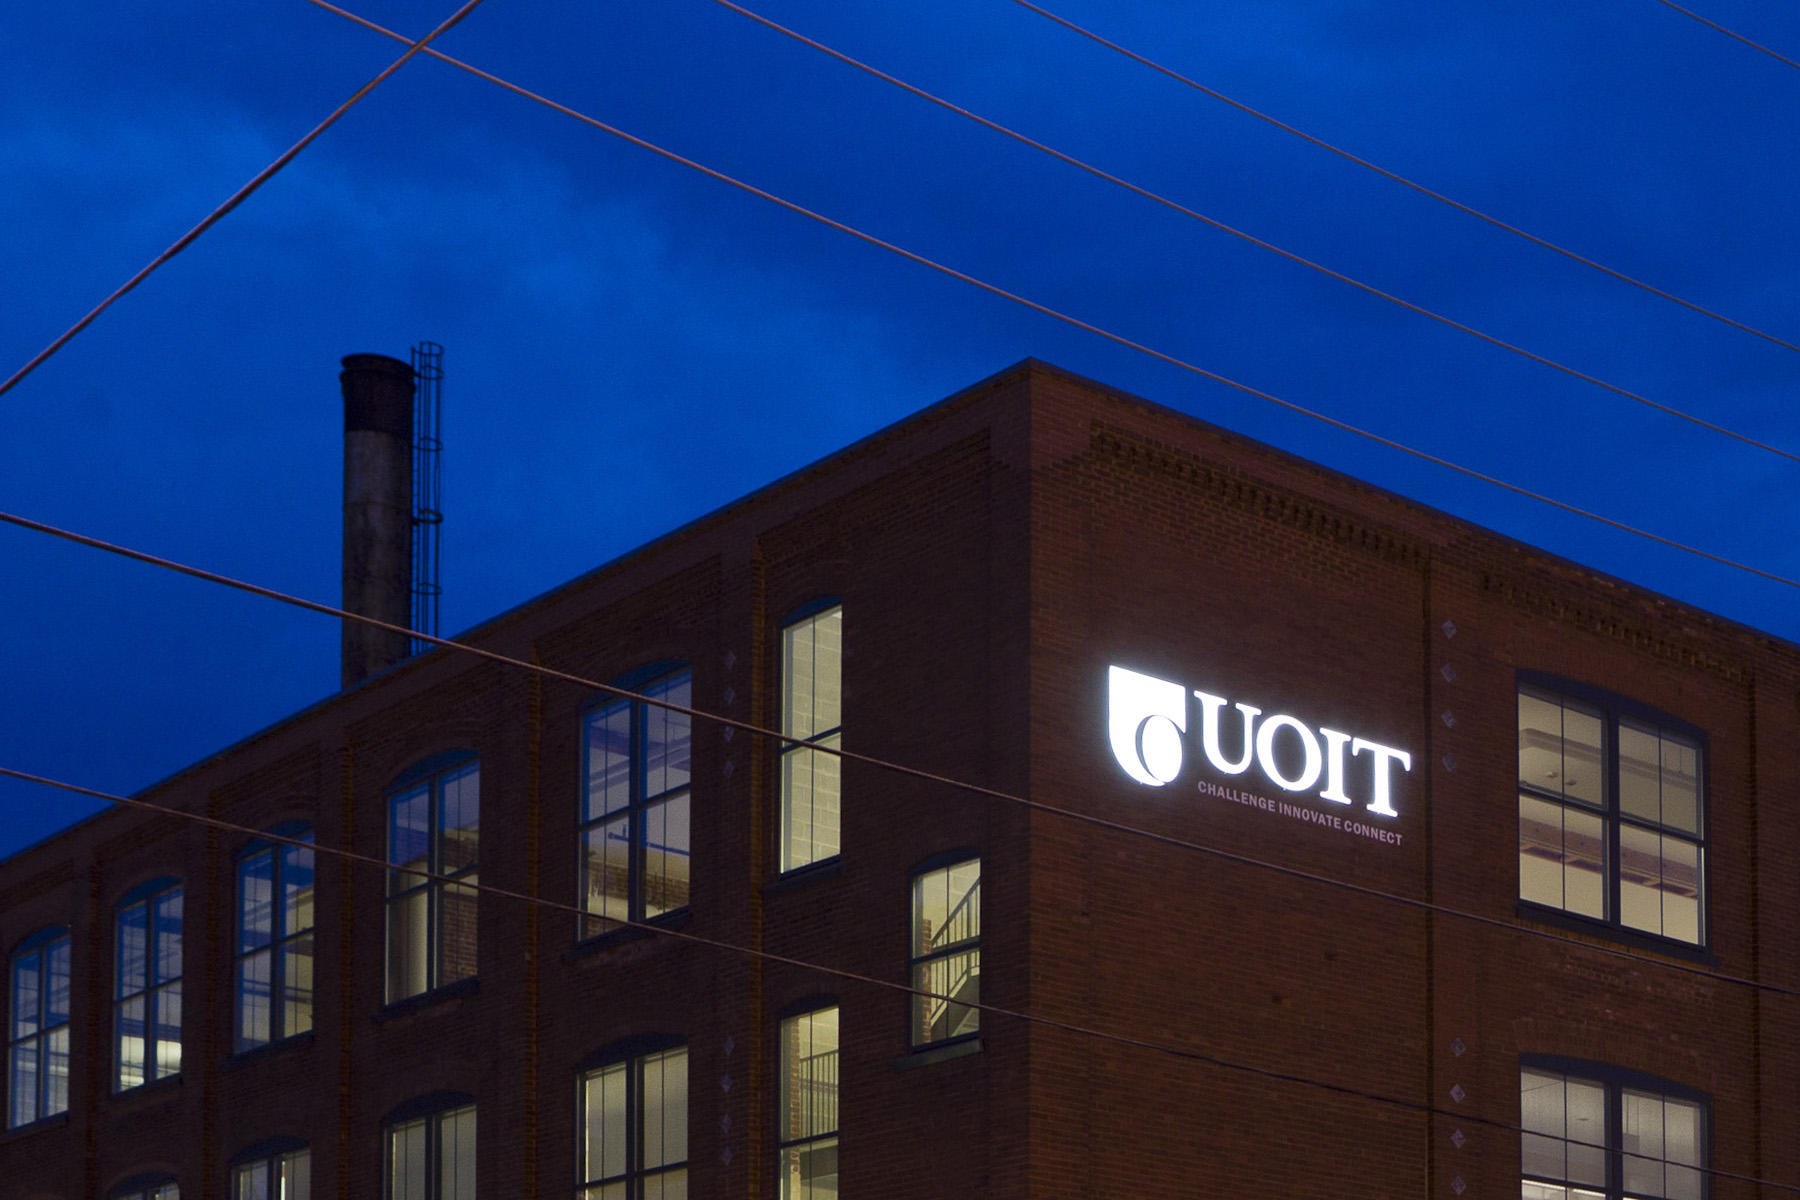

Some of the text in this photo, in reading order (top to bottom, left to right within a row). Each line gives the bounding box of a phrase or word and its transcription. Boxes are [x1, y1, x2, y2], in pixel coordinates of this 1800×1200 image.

[1193, 689, 1412, 818] UOIT
[1196, 779, 1403, 846] CHALLENGE INNOVATE CONNECT
